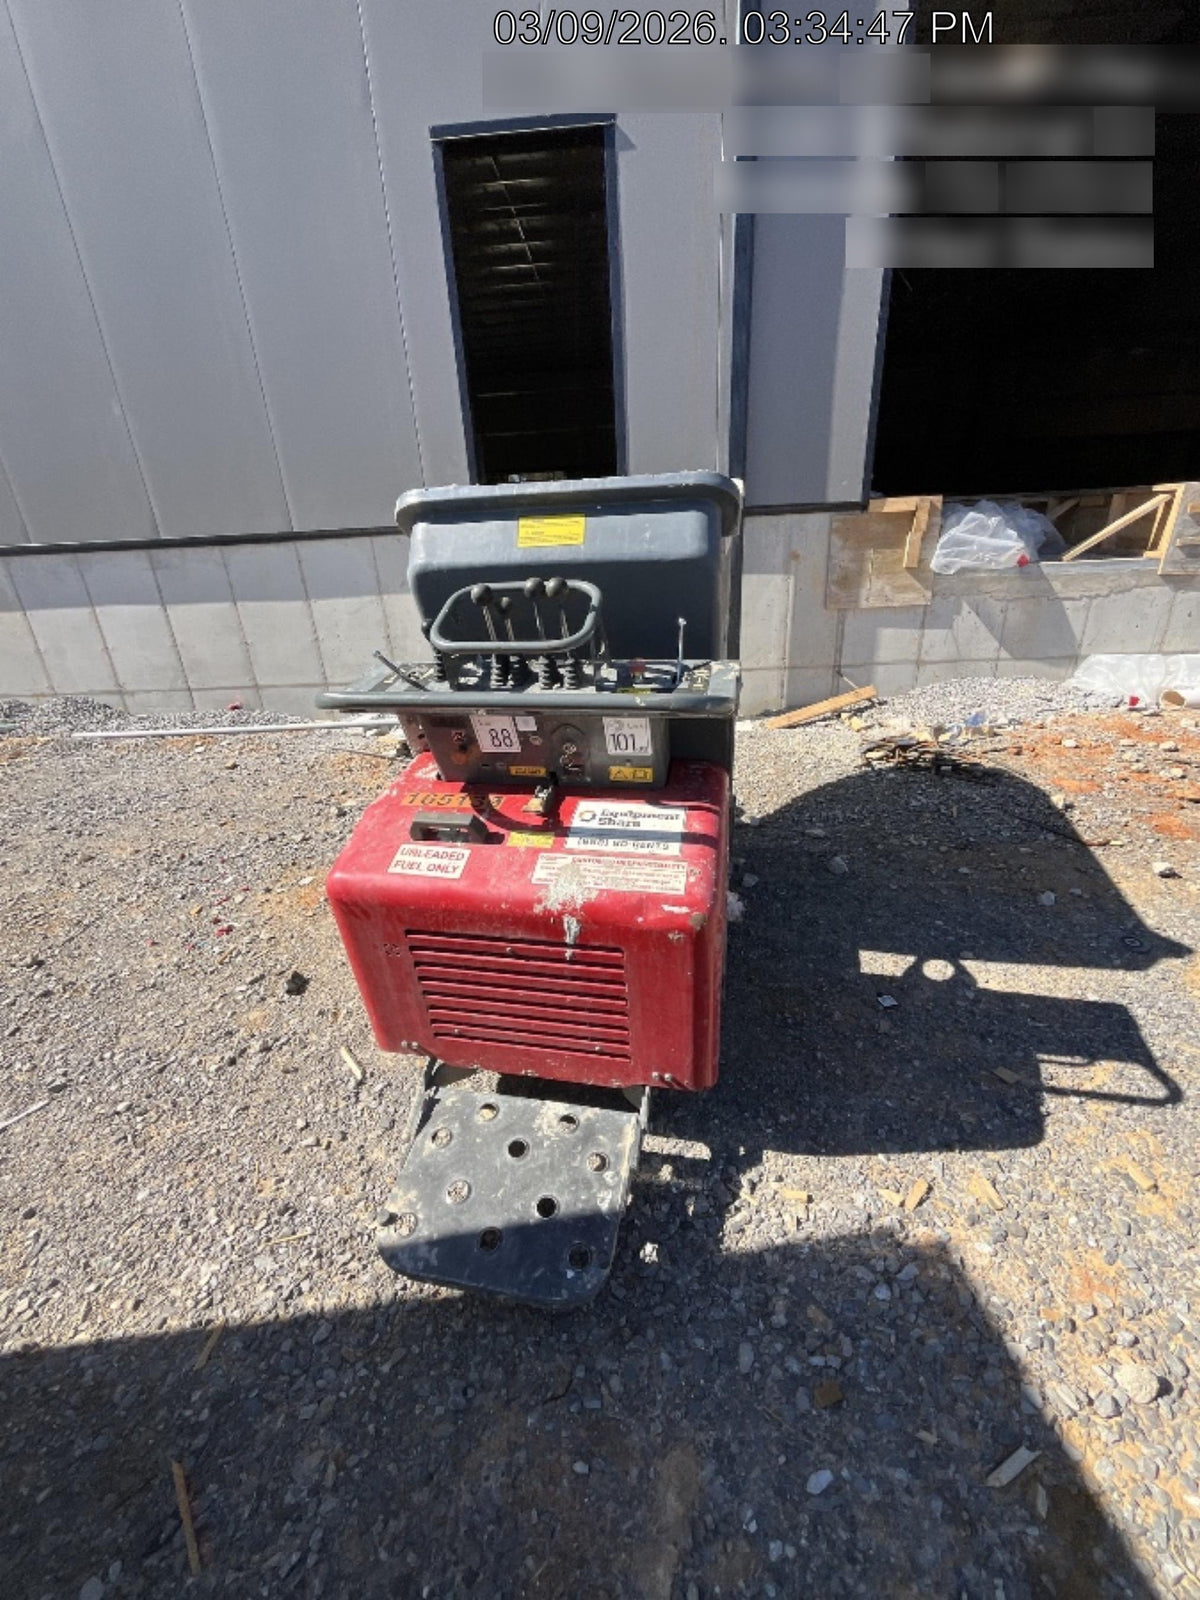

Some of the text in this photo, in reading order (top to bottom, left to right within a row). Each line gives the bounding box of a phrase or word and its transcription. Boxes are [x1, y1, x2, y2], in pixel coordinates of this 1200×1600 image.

[489, 728, 513, 748] 88
[609, 733, 636, 752] 101
[399, 847, 465, 861] UNLEADED
[393, 860, 460, 874] FUEL ONLY
